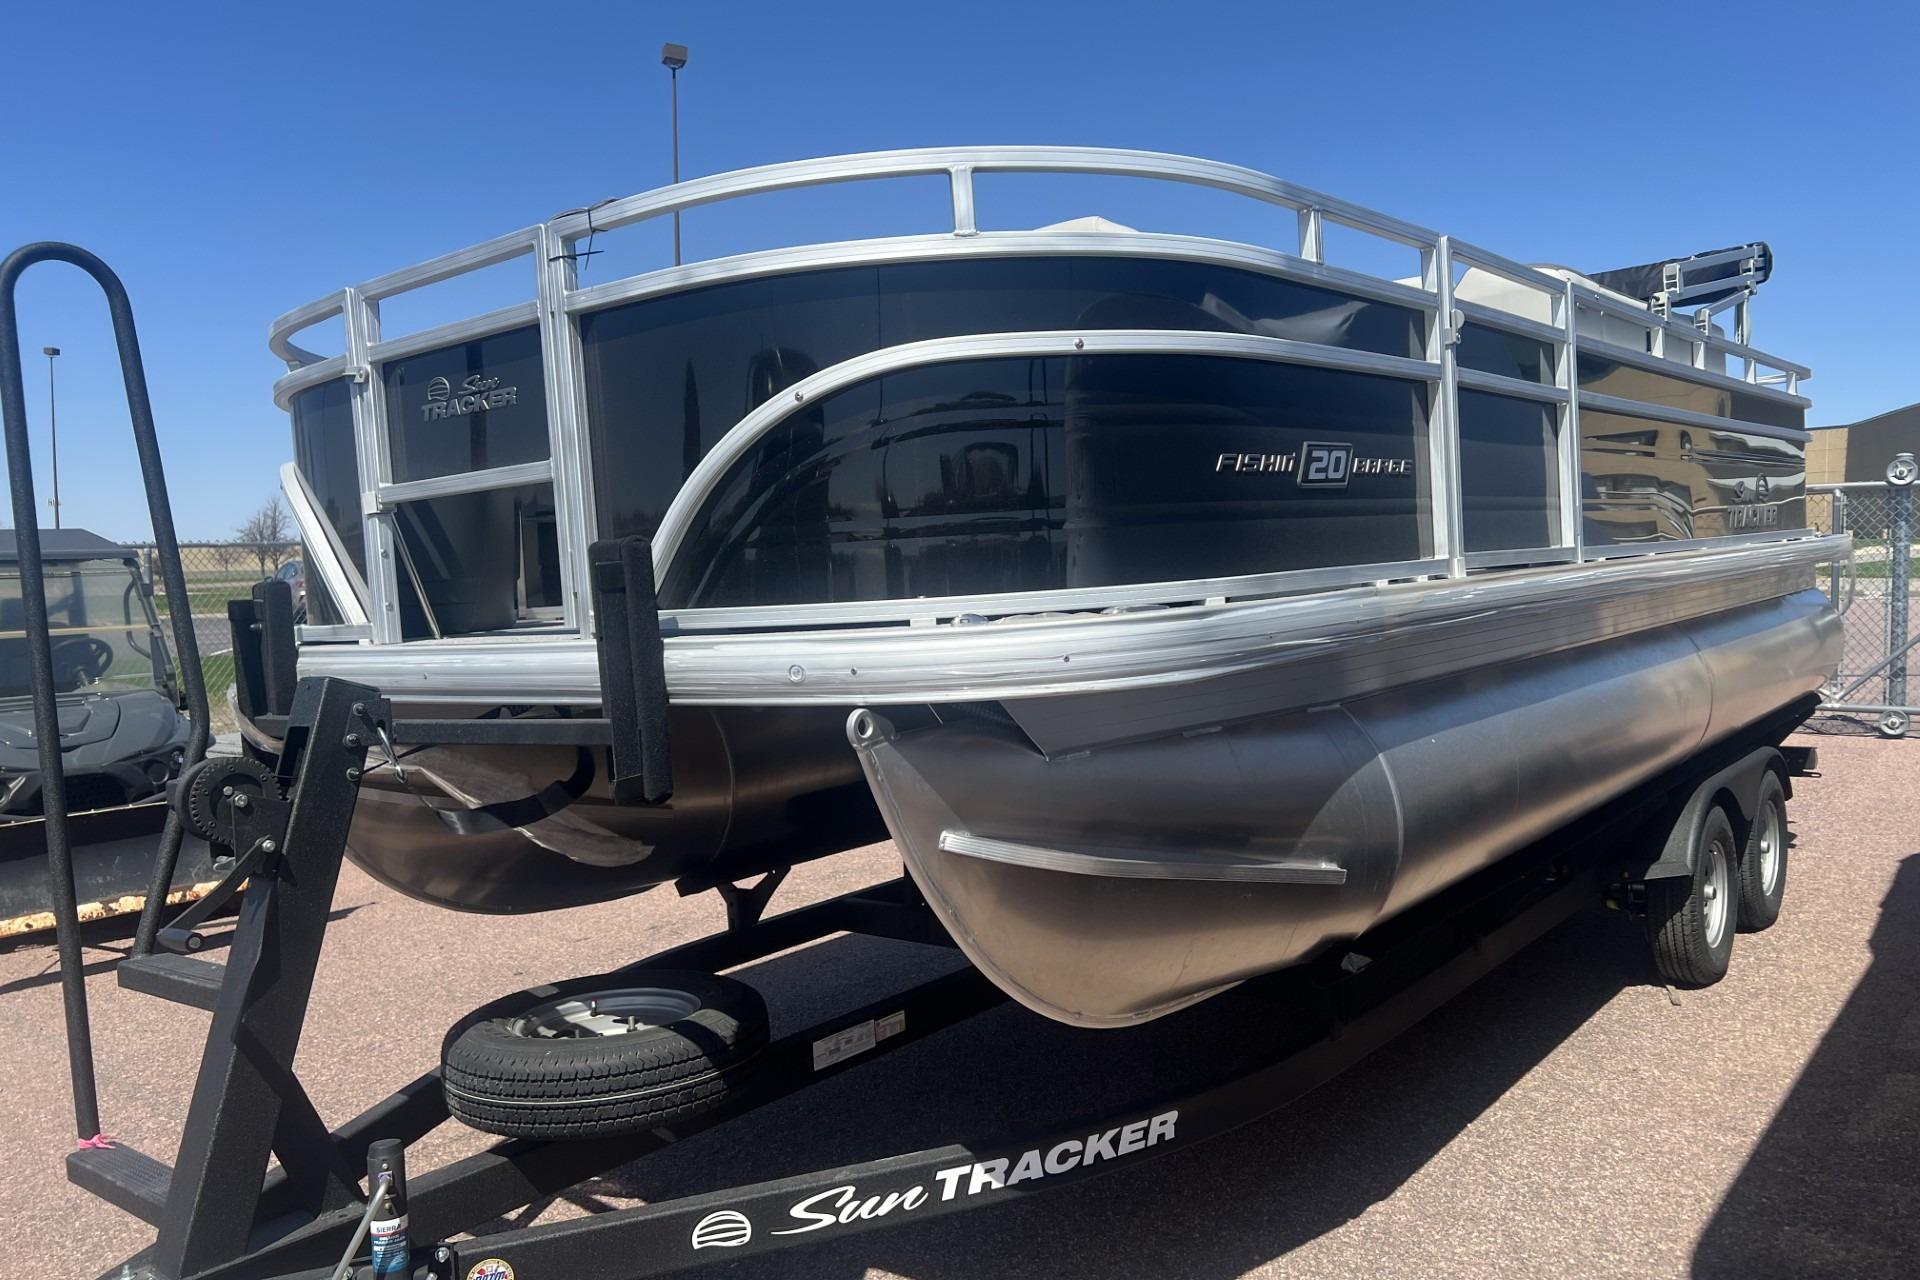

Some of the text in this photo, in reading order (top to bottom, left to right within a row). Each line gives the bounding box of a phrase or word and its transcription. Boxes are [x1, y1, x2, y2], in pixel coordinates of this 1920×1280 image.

[421, 386, 518, 422] TRACKER
[1308, 450, 1347, 480] 20
[1352, 457, 1413, 474] BARGE
[770, 1109, 1179, 1235] Sun TRACKER
